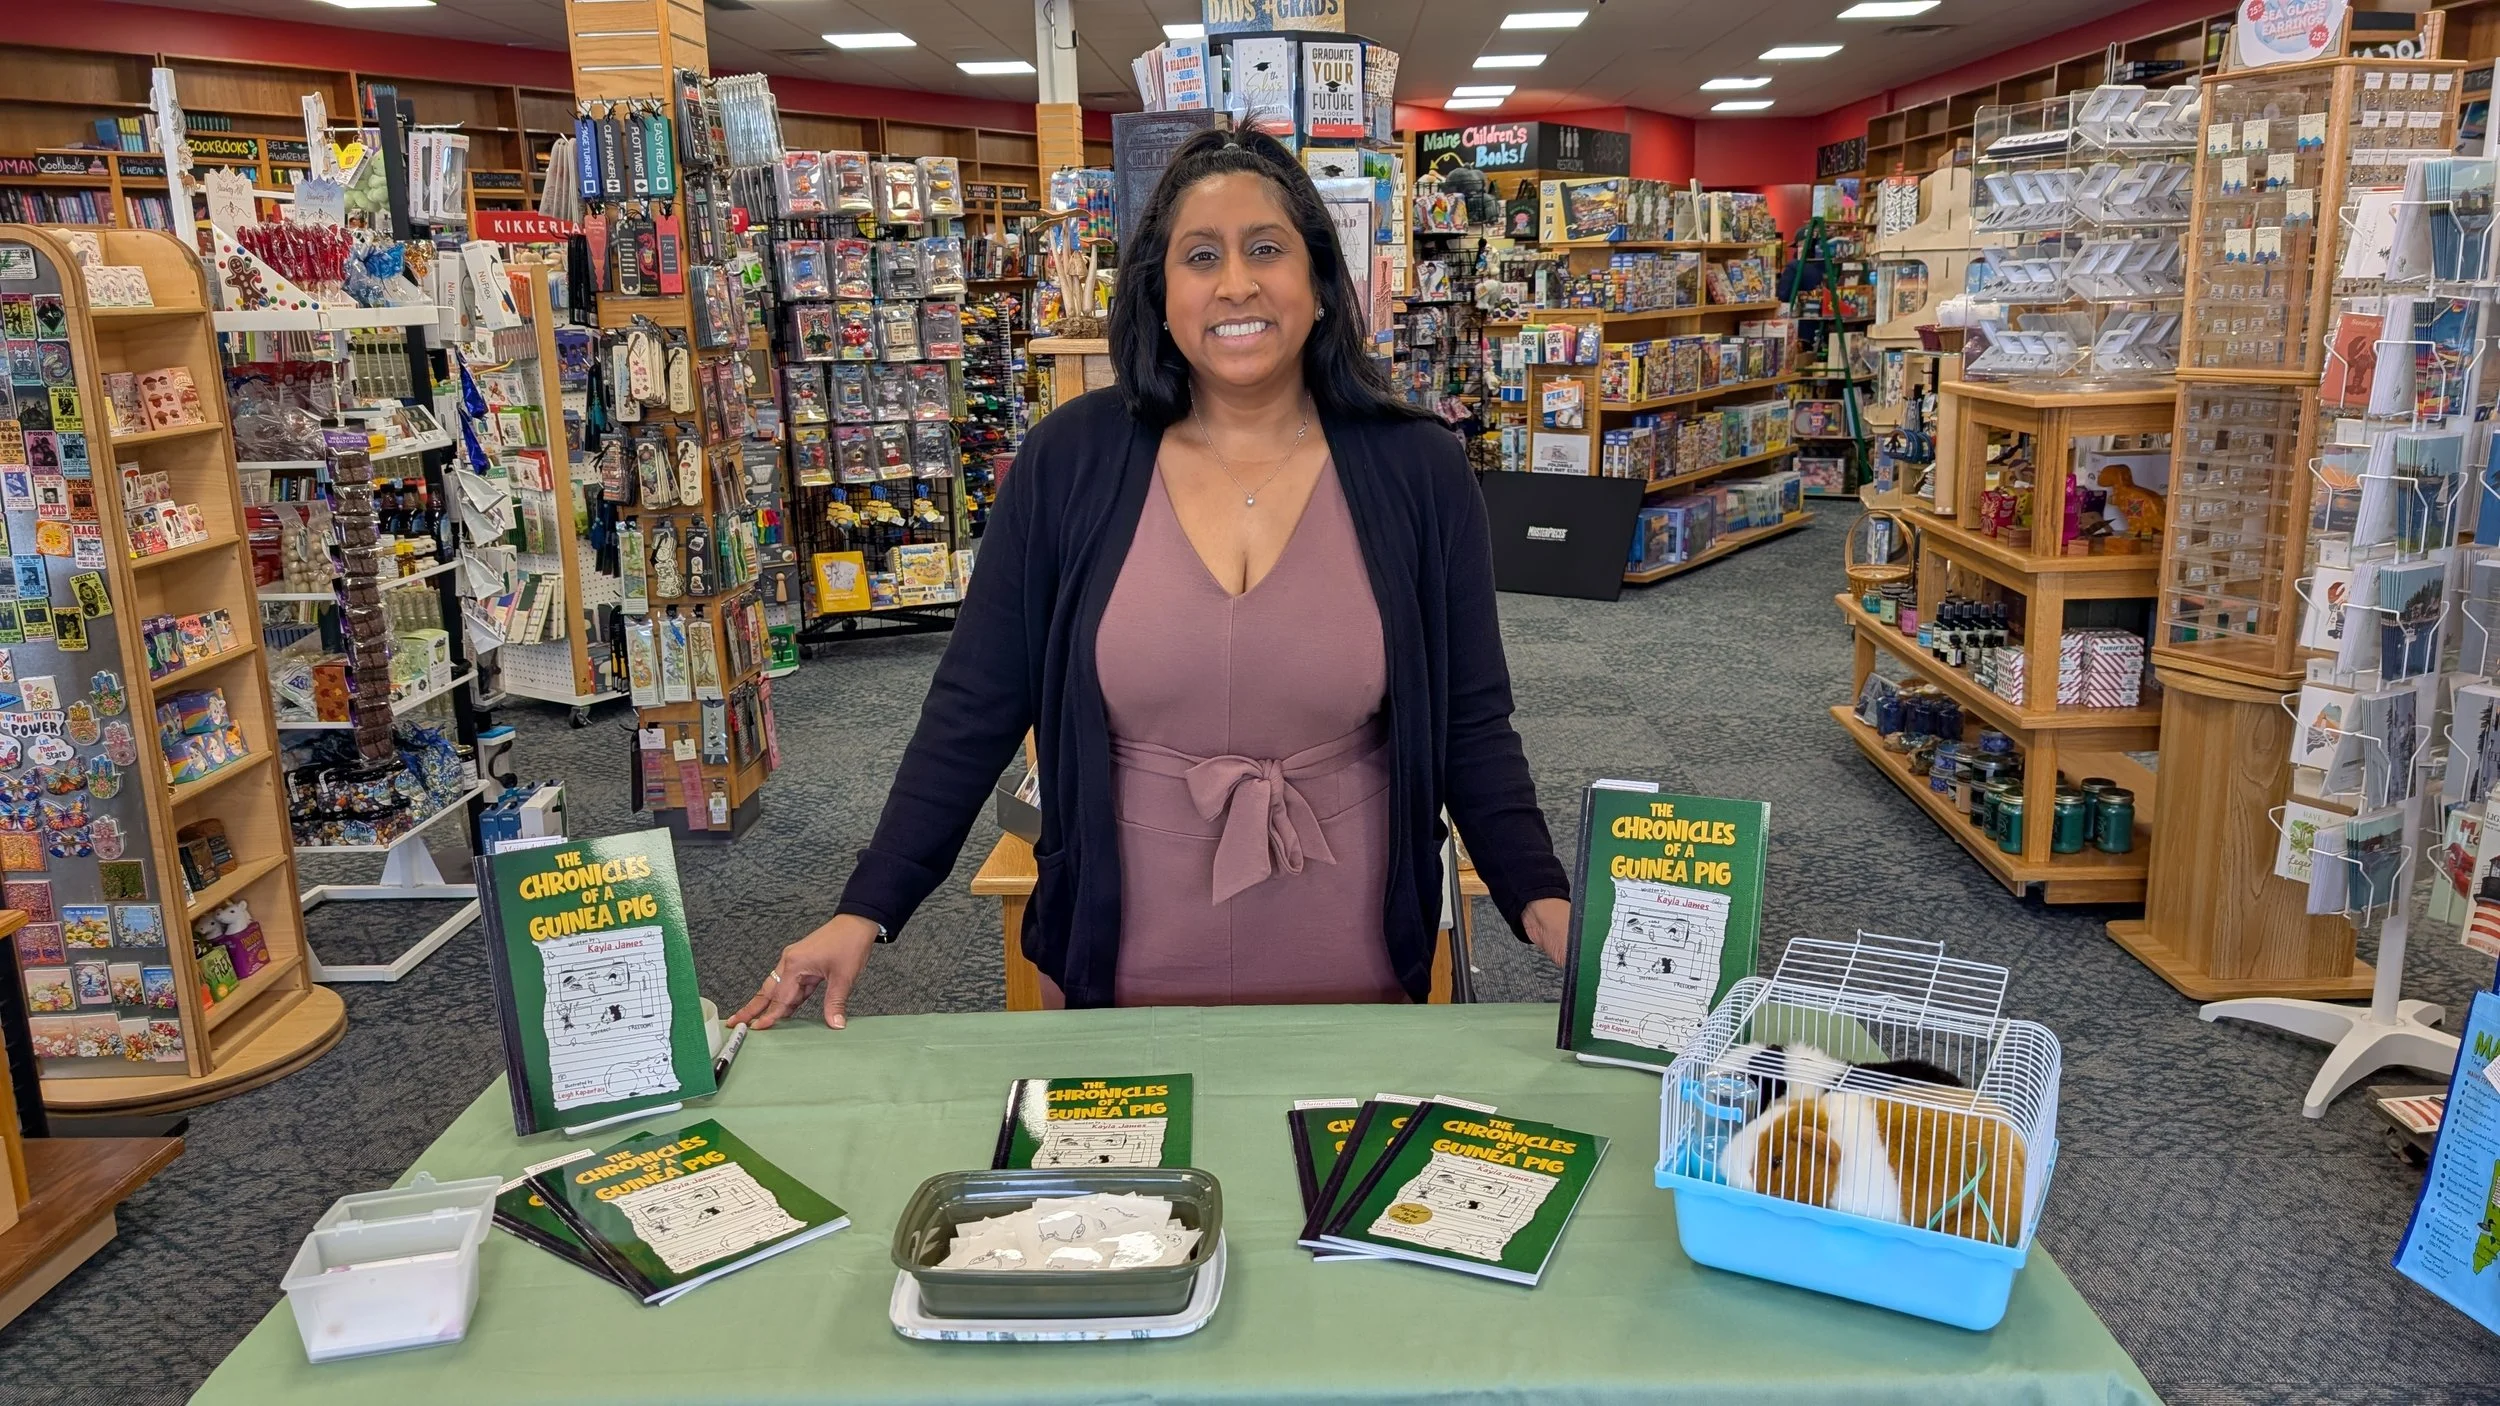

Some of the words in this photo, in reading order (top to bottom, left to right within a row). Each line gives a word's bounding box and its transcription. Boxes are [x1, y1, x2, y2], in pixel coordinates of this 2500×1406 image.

[1208, 0, 1256, 24] DADS
[1276, 0, 1339, 19] GRADS
[2263, 9, 2284, 21] SEA
[2287, 0, 2327, 15] GLASS
[2263, 14, 2325, 36] EARRINGS
[1312, 48, 1354, 61] GRADUATE
[1312, 61, 1354, 86] YOUR
[1246, 71, 1283, 104] Sky's
[1312, 93, 1354, 111] FUTURE
[603, 124, 613, 145] CLIFF
[631, 126, 641, 150] PLOT
[653, 122, 664, 147] EASY
[1424, 132, 1461, 151] Maine
[1462, 126, 1528, 147] Children's
[187, 138, 249, 155] COOKBOOKS
[267, 141, 290, 150] SELF
[583, 147, 593, 178] TURNER
[605, 146, 616, 179] HANGER
[656, 148, 666, 174] READ
[1475, 142, 1529, 168] Books!
[38, 156, 85, 173] Cookbooks
[127, 166, 154, 175] HEALTH
[634, 151, 645, 178] TWIST
[494, 219, 586, 234] KIKKERLA
[478, 271, 491, 300] NuFlex
[39, 504, 67, 516] ELVIS
[73, 526, 101, 535] RAGE
[75, 573, 92, 581] OZZY
[31, 699, 53, 711] ROSES
[11, 721, 60, 735] POWER
[38, 745, 57, 754] Them
[46, 751, 67, 760] Stare
[1650, 803, 1674, 818] THE
[2303, 811, 2322, 822] HAVE
[1611, 816, 1736, 846] CHRONICLES
[554, 850, 582, 869] THE
[1664, 843, 1681, 857] OF
[1684, 844, 1695, 858] A
[519, 855, 651, 900] CHRONICLES
[1610, 855, 1688, 883] GUINEA
[1694, 861, 1732, 886] PIG
[581, 888, 599, 905] OF
[603, 886, 615, 901] A
[1656, 895, 1680, 907] Kayla
[1682, 899, 1710, 911] James
[529, 904, 615, 942] GUINEA
[616, 894, 658, 924] PIG
[587, 941, 613, 954] Kayla
[615, 939, 644, 950] James
[1595, 1022, 1610, 1031] Leigh
[1044, 1085, 1169, 1102] CHRONICLES
[1082, 1081, 1106, 1089] THE
[558, 1089, 574, 1100] Leigh
[1044, 1106, 1123, 1121] GUINEA
[1130, 1102, 1167, 1116] PIG
[1488, 1119, 1515, 1131] THE
[1442, 1120, 1577, 1155] CHRONICLES
[604, 1150, 632, 1163] THE
[1433, 1139, 1517, 1166] GUINEA
[1522, 1155, 1565, 1173] PIG
[1495, 1142, 1515, 1151] OF
[1516, 1146, 1528, 1155] A
[575, 1135, 709, 1185] CHRONICLES
[642, 1162, 662, 1173] OF
[594, 1166, 685, 1201] GUINEA
[681, 1151, 727, 1172] PIG
[663, 1180, 690, 1193] Kayla
[691, 1171, 721, 1184] James
[1476, 1165, 1502, 1177] Kayla
[1504, 1172, 1535, 1183] James
